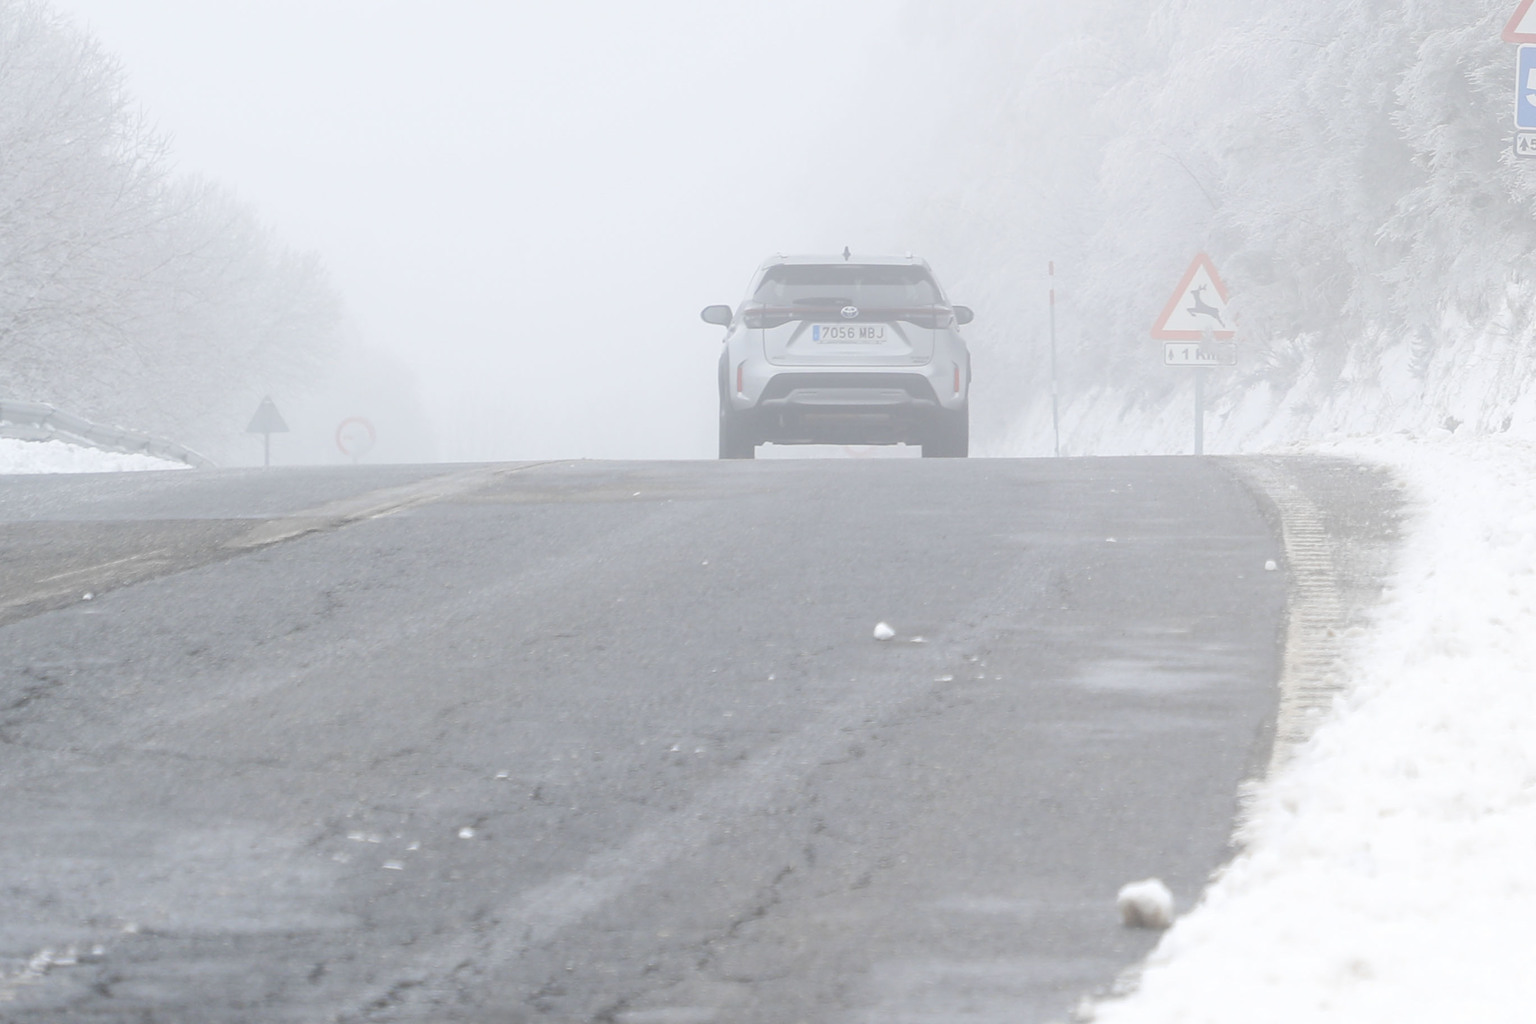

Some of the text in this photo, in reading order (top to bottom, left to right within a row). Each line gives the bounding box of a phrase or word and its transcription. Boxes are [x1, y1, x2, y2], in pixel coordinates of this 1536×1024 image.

[822, 327, 884, 339] 7056 MBJ
[1182, 348, 1189, 360] 1
